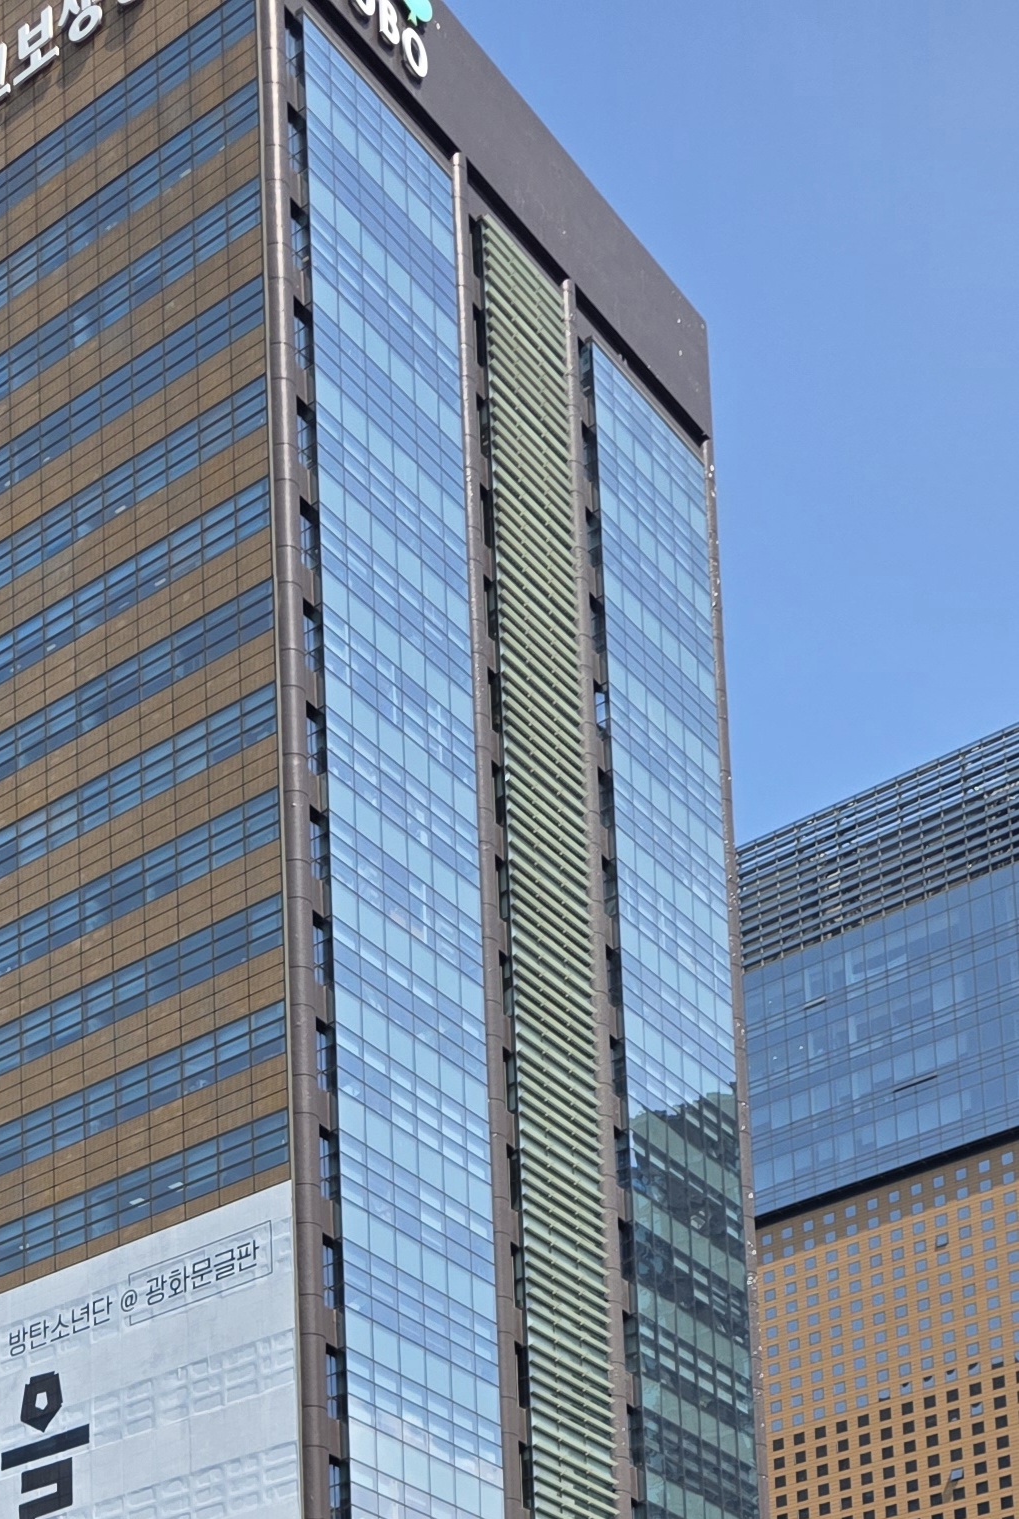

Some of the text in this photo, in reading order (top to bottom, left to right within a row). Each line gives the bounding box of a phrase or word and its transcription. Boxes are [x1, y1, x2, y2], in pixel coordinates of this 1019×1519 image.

[7, 1239, 260, 1357] 방탄소년단 @ 광화문글판
